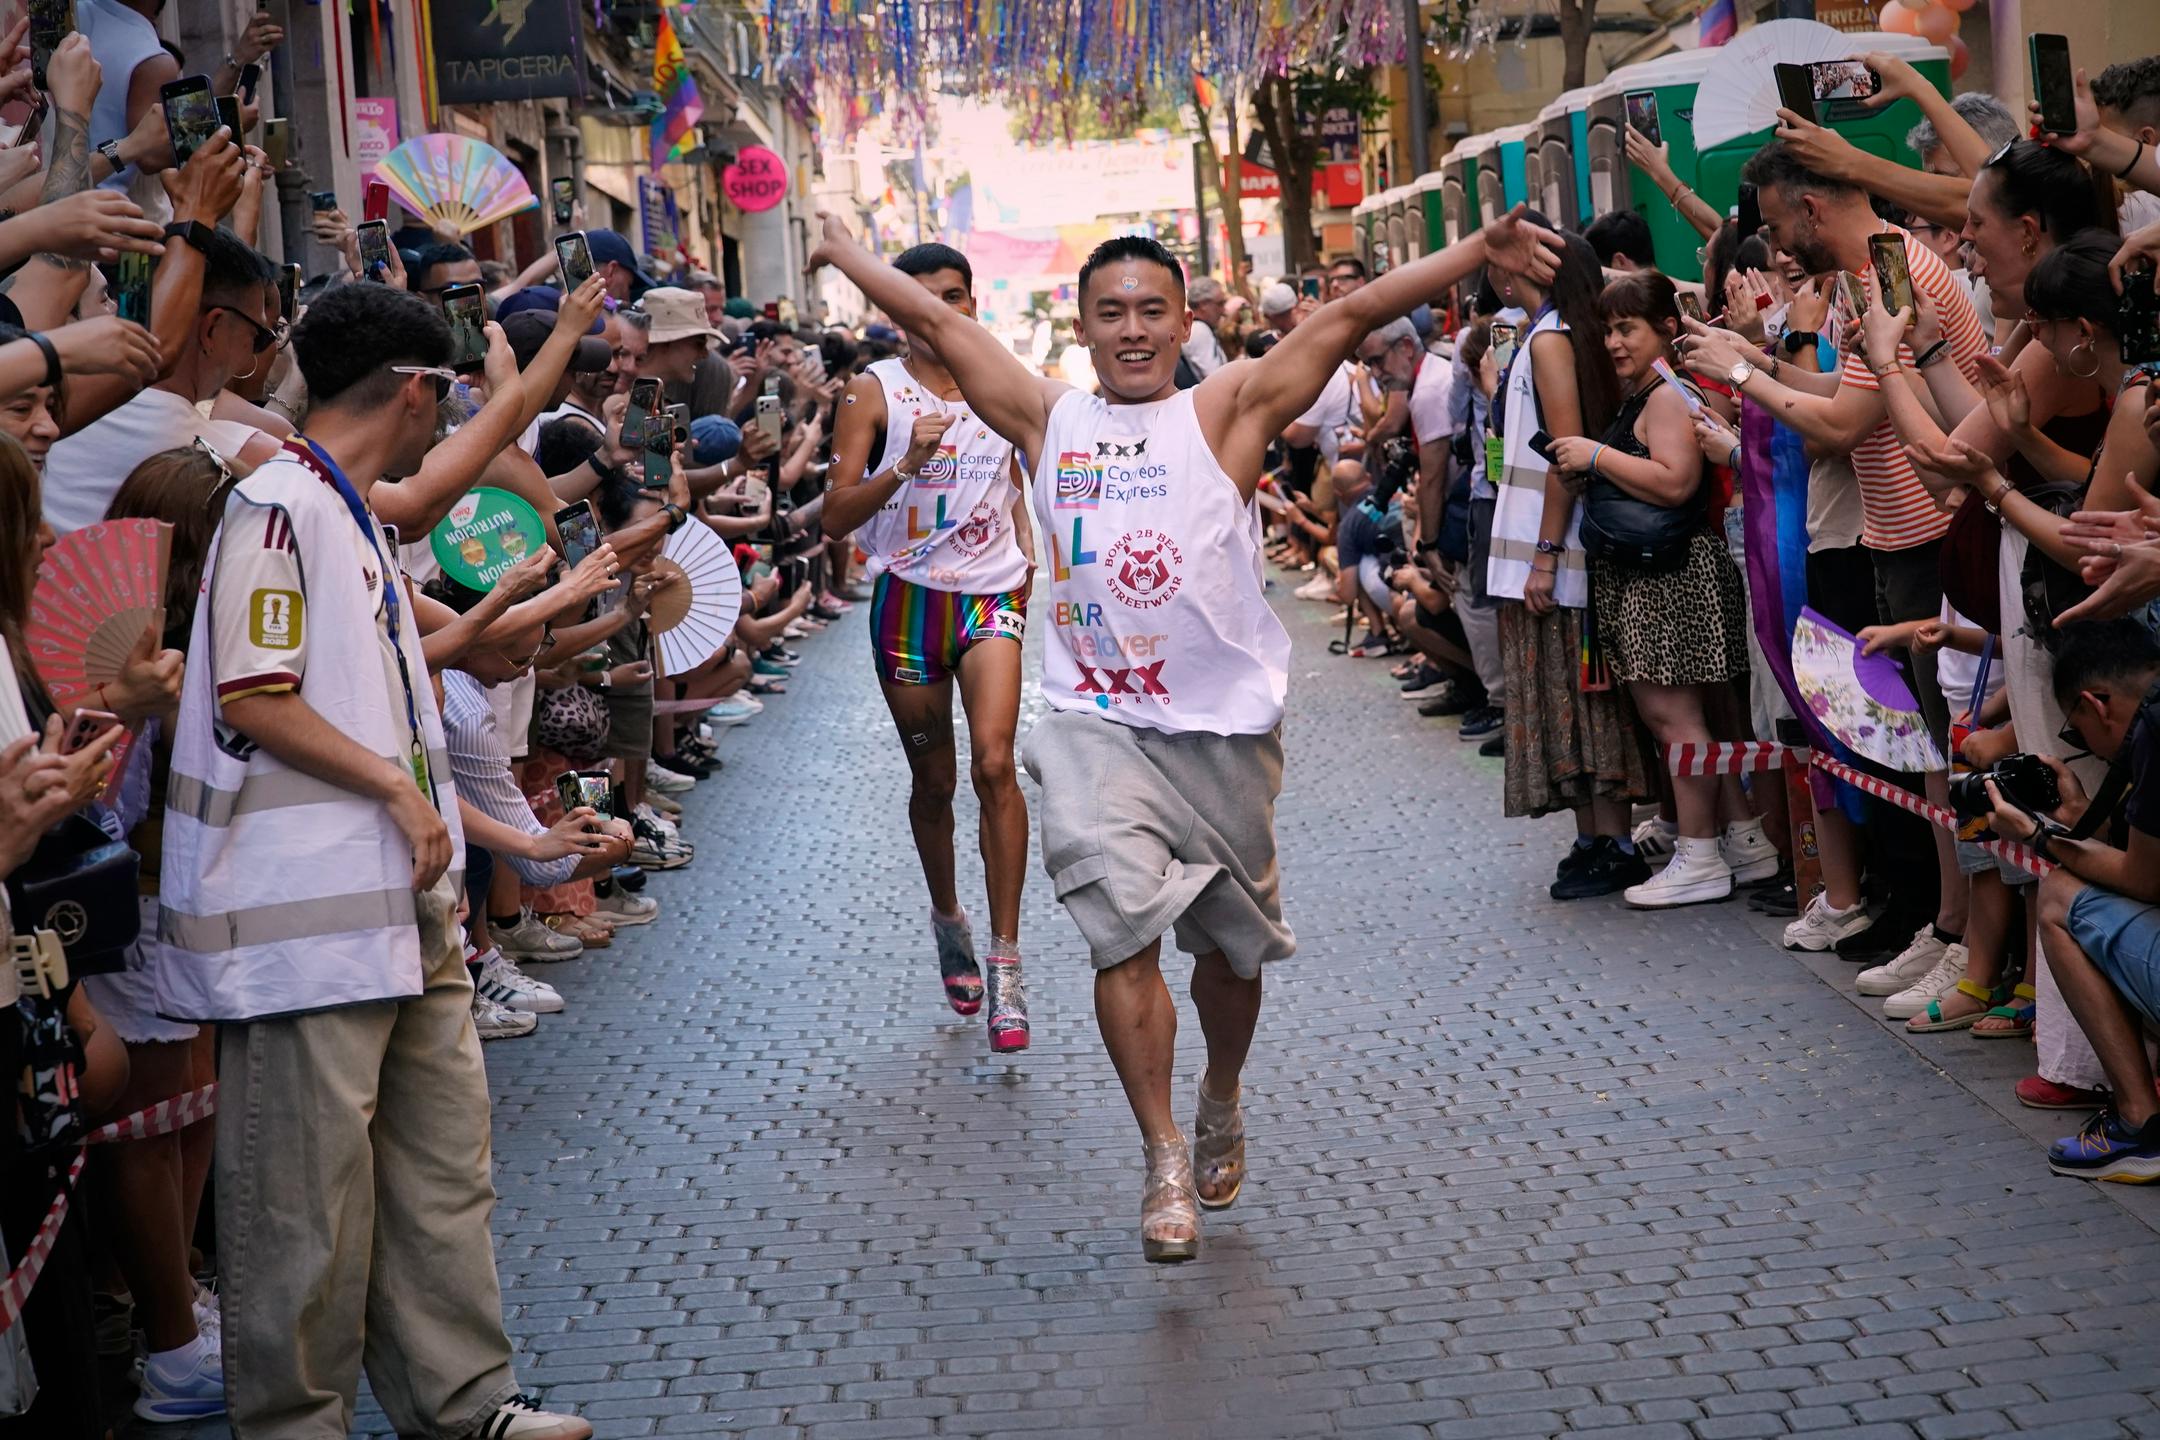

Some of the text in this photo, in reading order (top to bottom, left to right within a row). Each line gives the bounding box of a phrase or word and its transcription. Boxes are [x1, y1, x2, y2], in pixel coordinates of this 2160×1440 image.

[446, 54, 577, 83] TAPICERIA
[738, 158, 772, 176] SEX
[730, 180, 782, 199] SHOP
[1105, 484, 1167, 504] Express
[1105, 529, 1183, 568] BORN 2B BEAR
[1106, 575, 1183, 609] STREETWEAR
[1056, 602, 1103, 627] BAR
[1073, 659, 1170, 695] XXX
